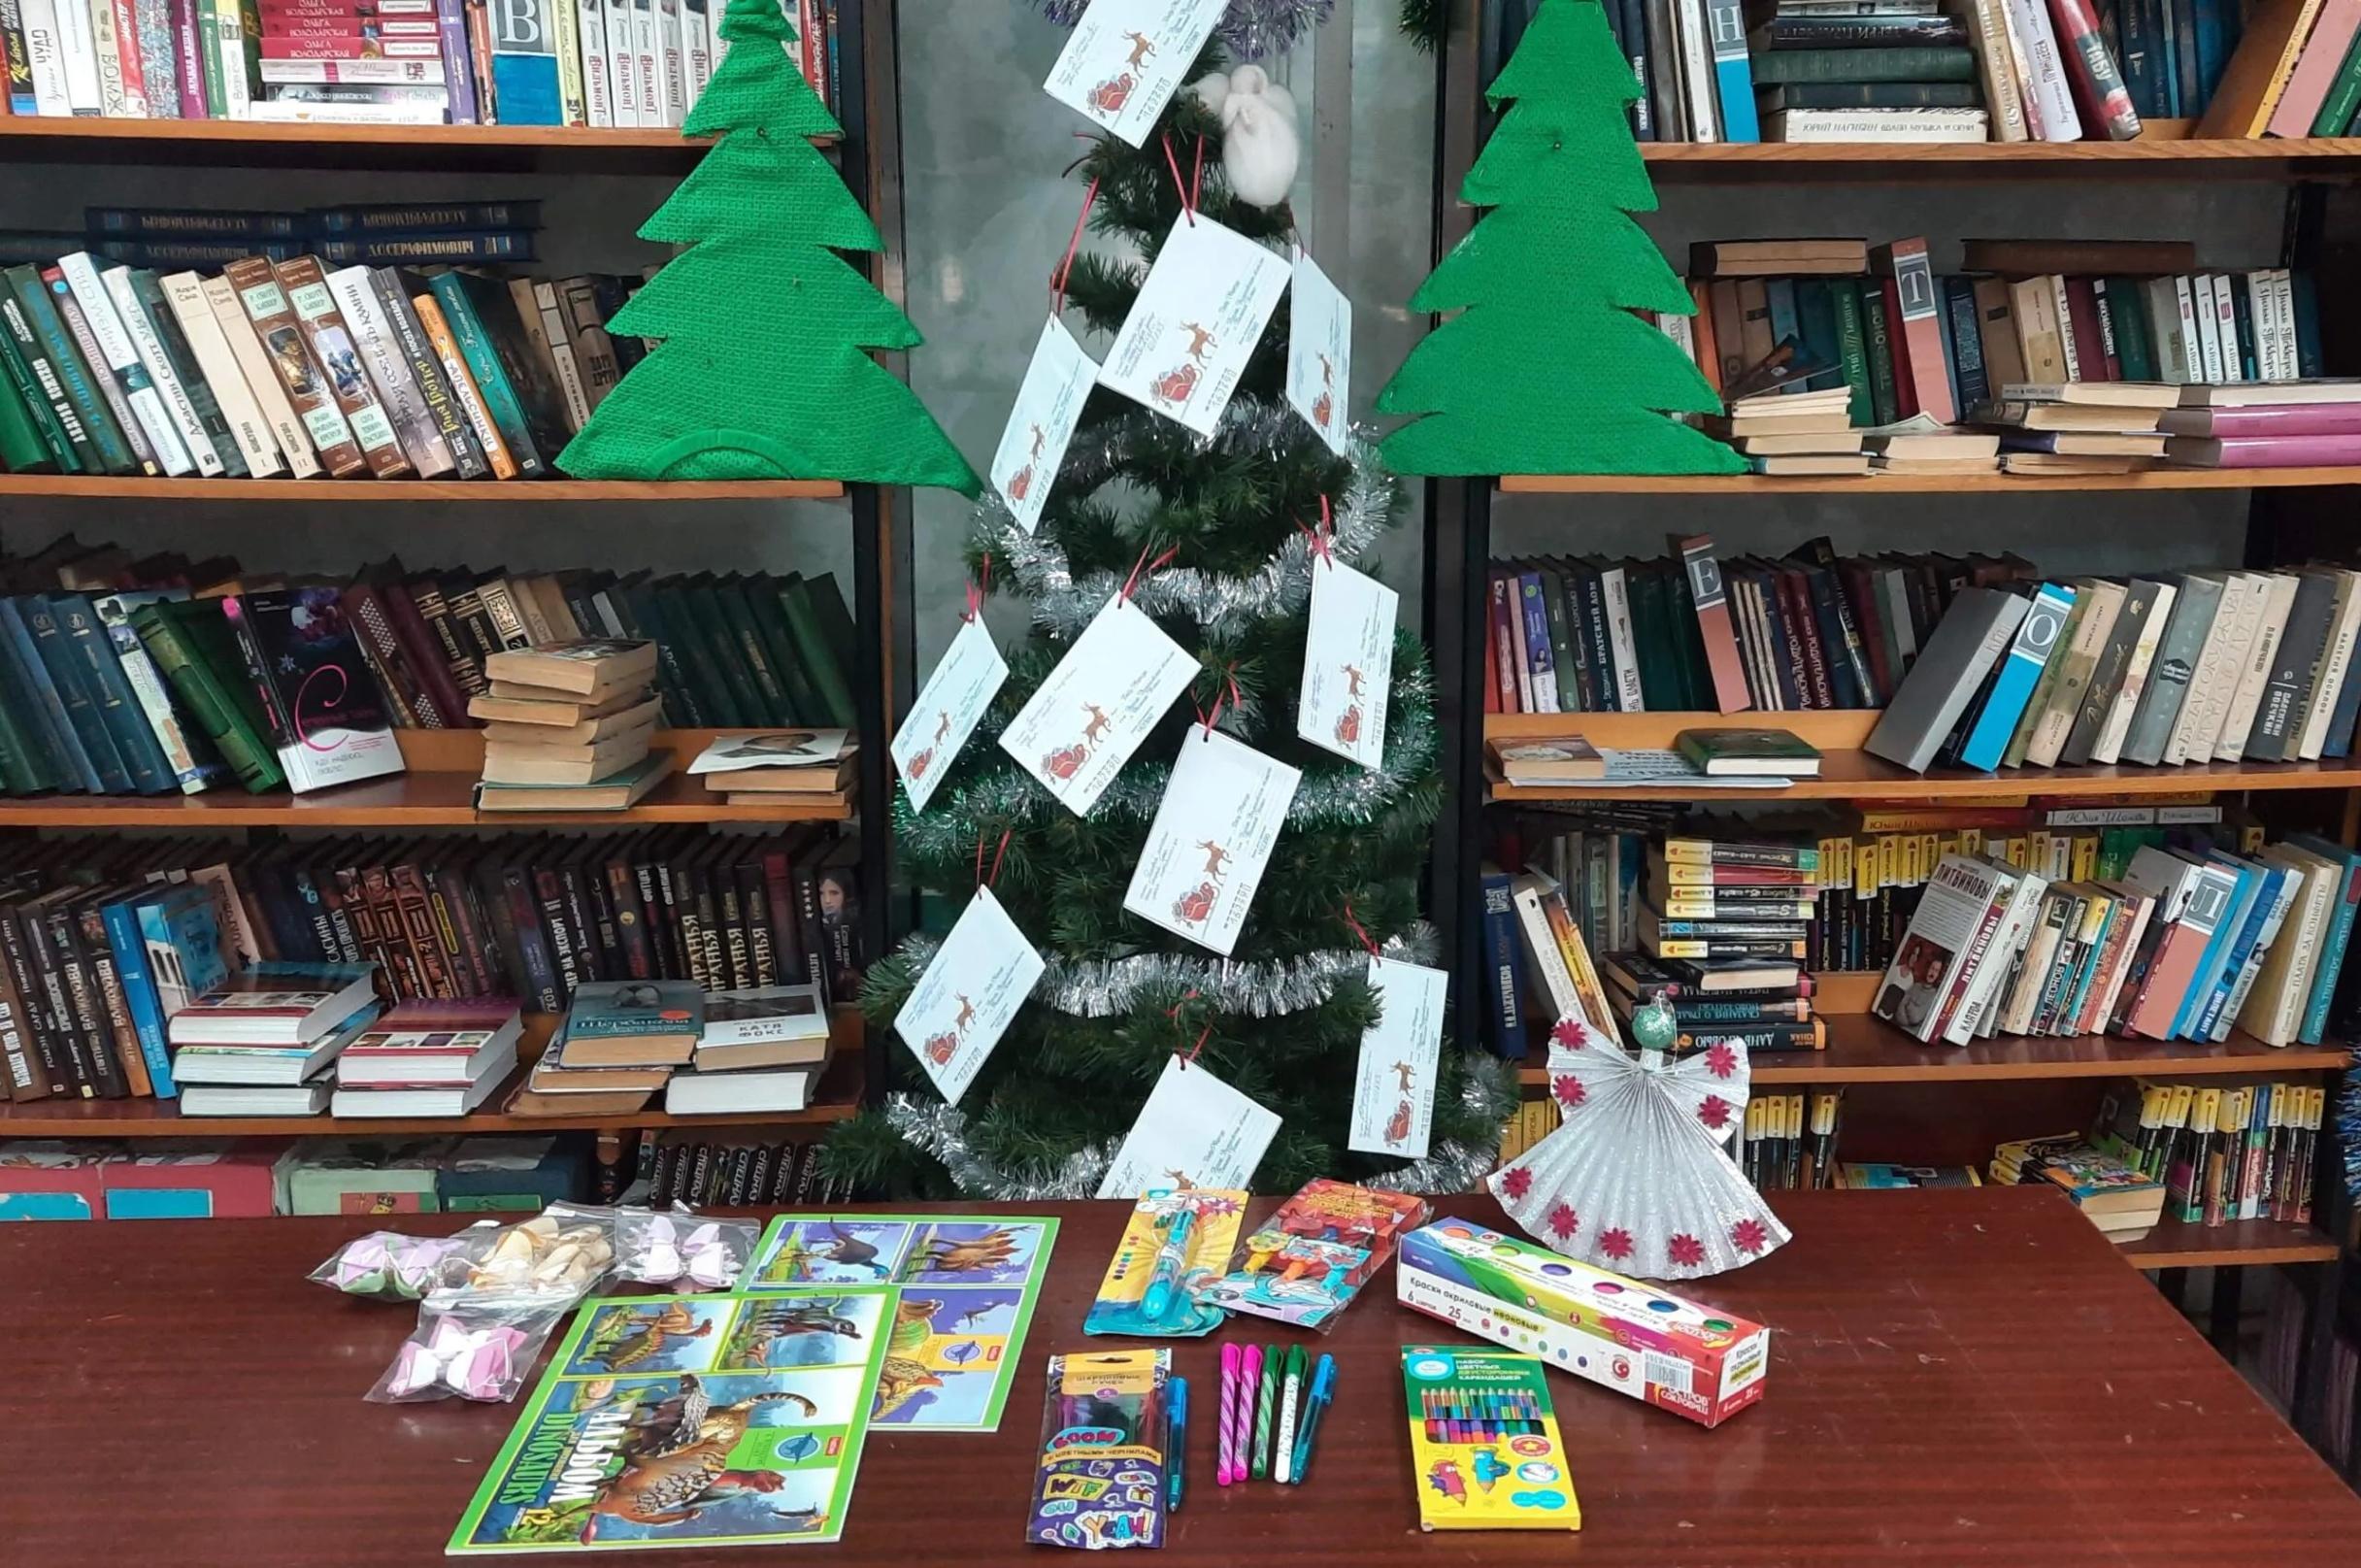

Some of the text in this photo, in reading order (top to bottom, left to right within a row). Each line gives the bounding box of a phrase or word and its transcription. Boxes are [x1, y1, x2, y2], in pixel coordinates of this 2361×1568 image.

[2087, 42, 2112, 82] ТАБУ
[1410, 1277, 1442, 1298] Краски
[1443, 1289, 1493, 1316] акриловые
[1447, 1305, 1462, 1320] 25
[498, 1413, 581, 1506] DINOSAURS
[549, 1411, 632, 1504] АЛЬБОМ
